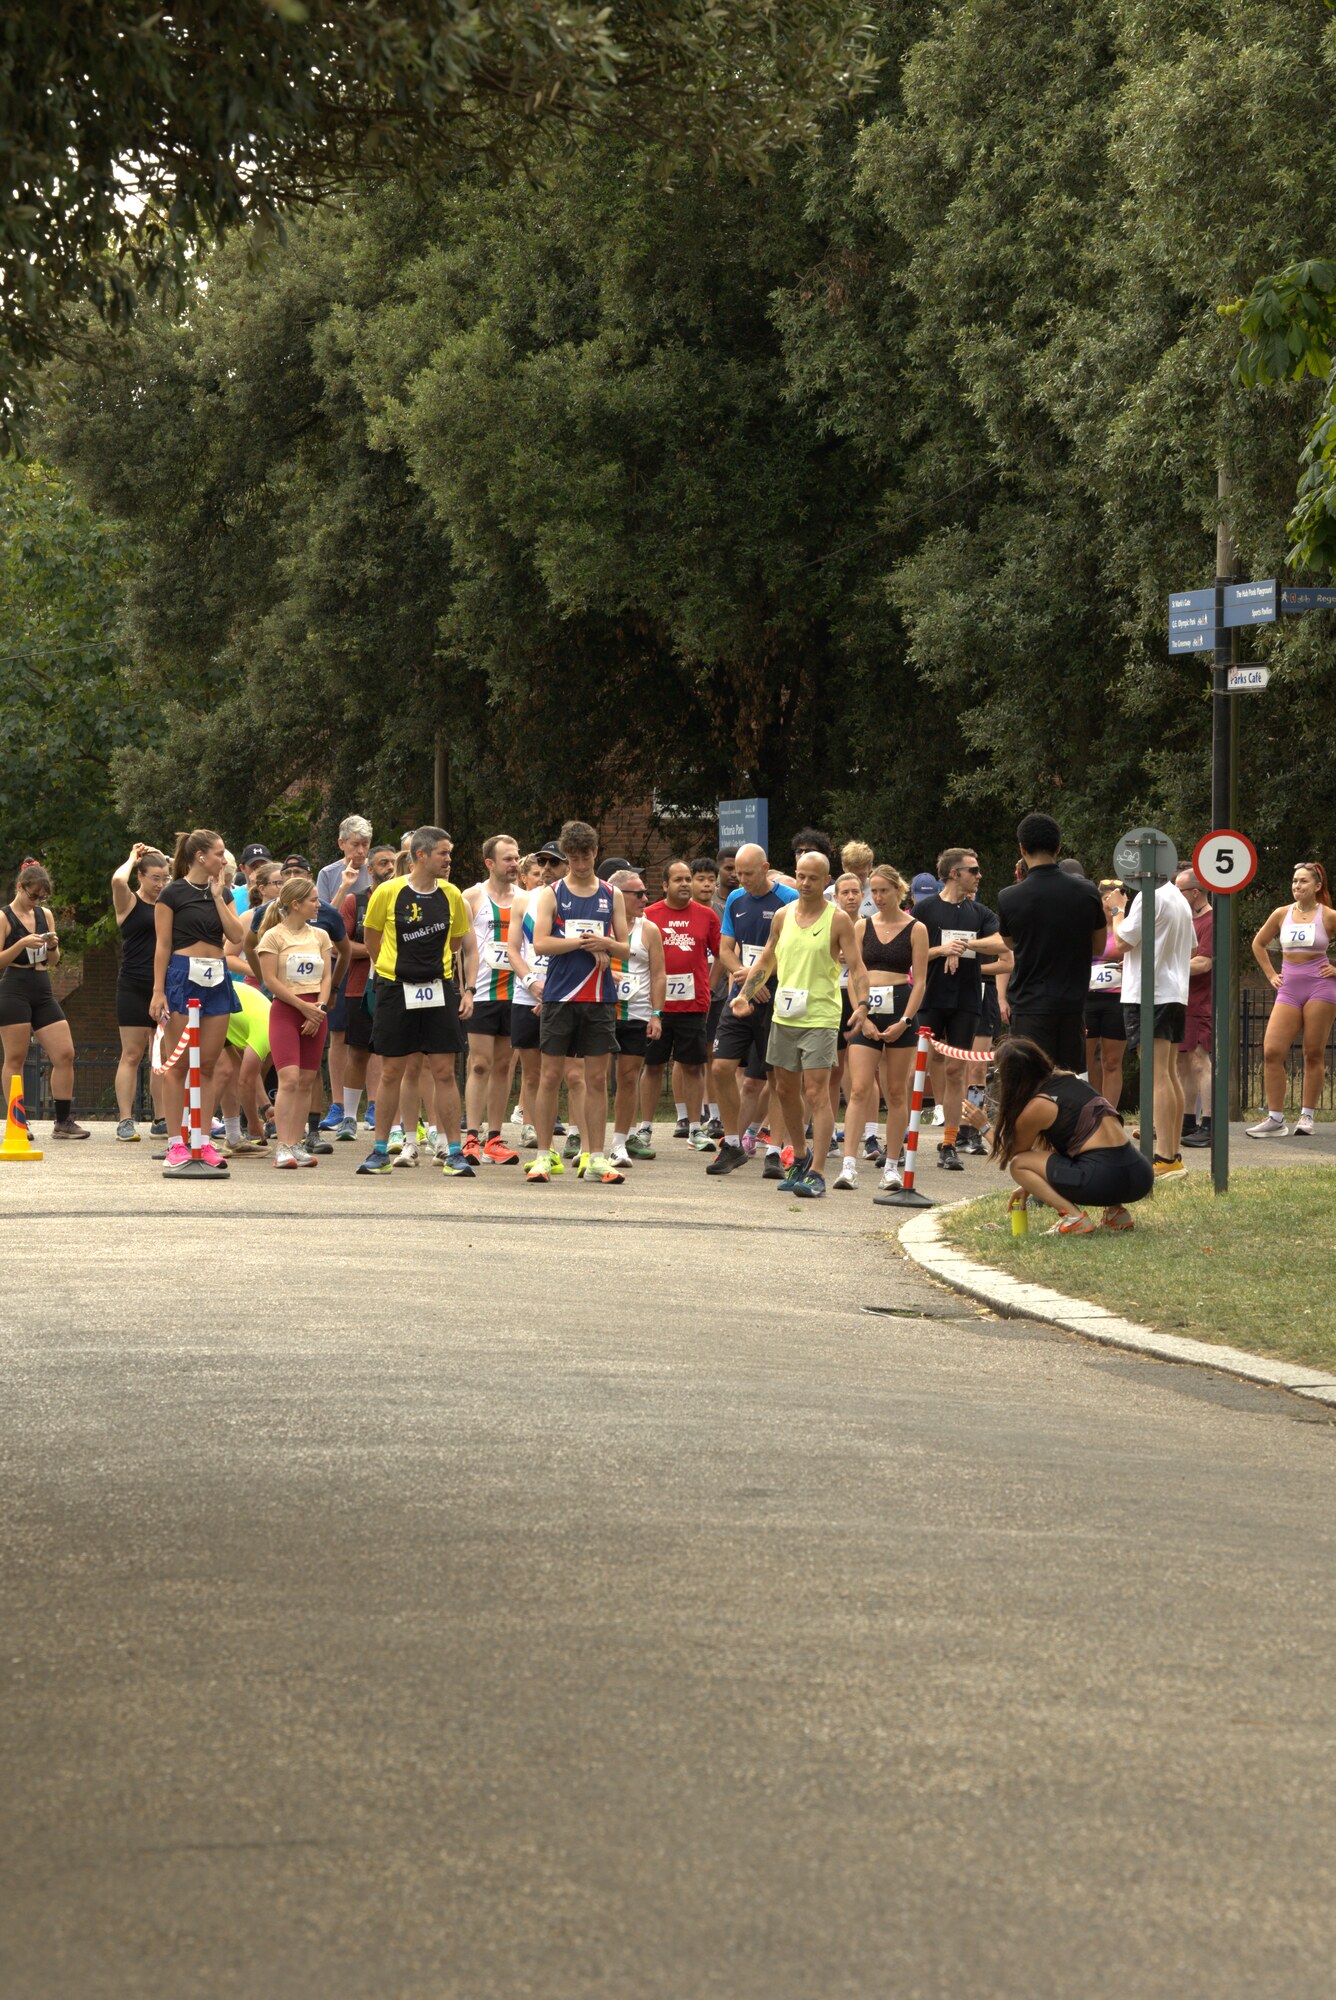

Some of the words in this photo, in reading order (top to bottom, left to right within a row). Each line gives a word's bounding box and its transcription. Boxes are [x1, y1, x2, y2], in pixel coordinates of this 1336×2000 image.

[1252, 608, 1261, 618] Sports
[1261, 606, 1272, 616] Pavilion
[1178, 619, 1190, 629] Olympic
[1248, 672, 1261, 684] Café
[721, 824, 735, 835] Victoria
[736, 824, 744, 835] Park
[1216, 849, 1234, 874] 5
[402, 922, 446, 942] Run&Frite
[1290, 931, 1305, 941] 76
[204, 967, 212, 980] 4
[296, 962, 314, 974] 49
[1096, 971, 1112, 982] 45
[415, 988, 433, 1000] 40
[668, 983, 686, 995] 72
[784, 998, 792, 1010] 7
[867, 995, 883, 1008] 29
